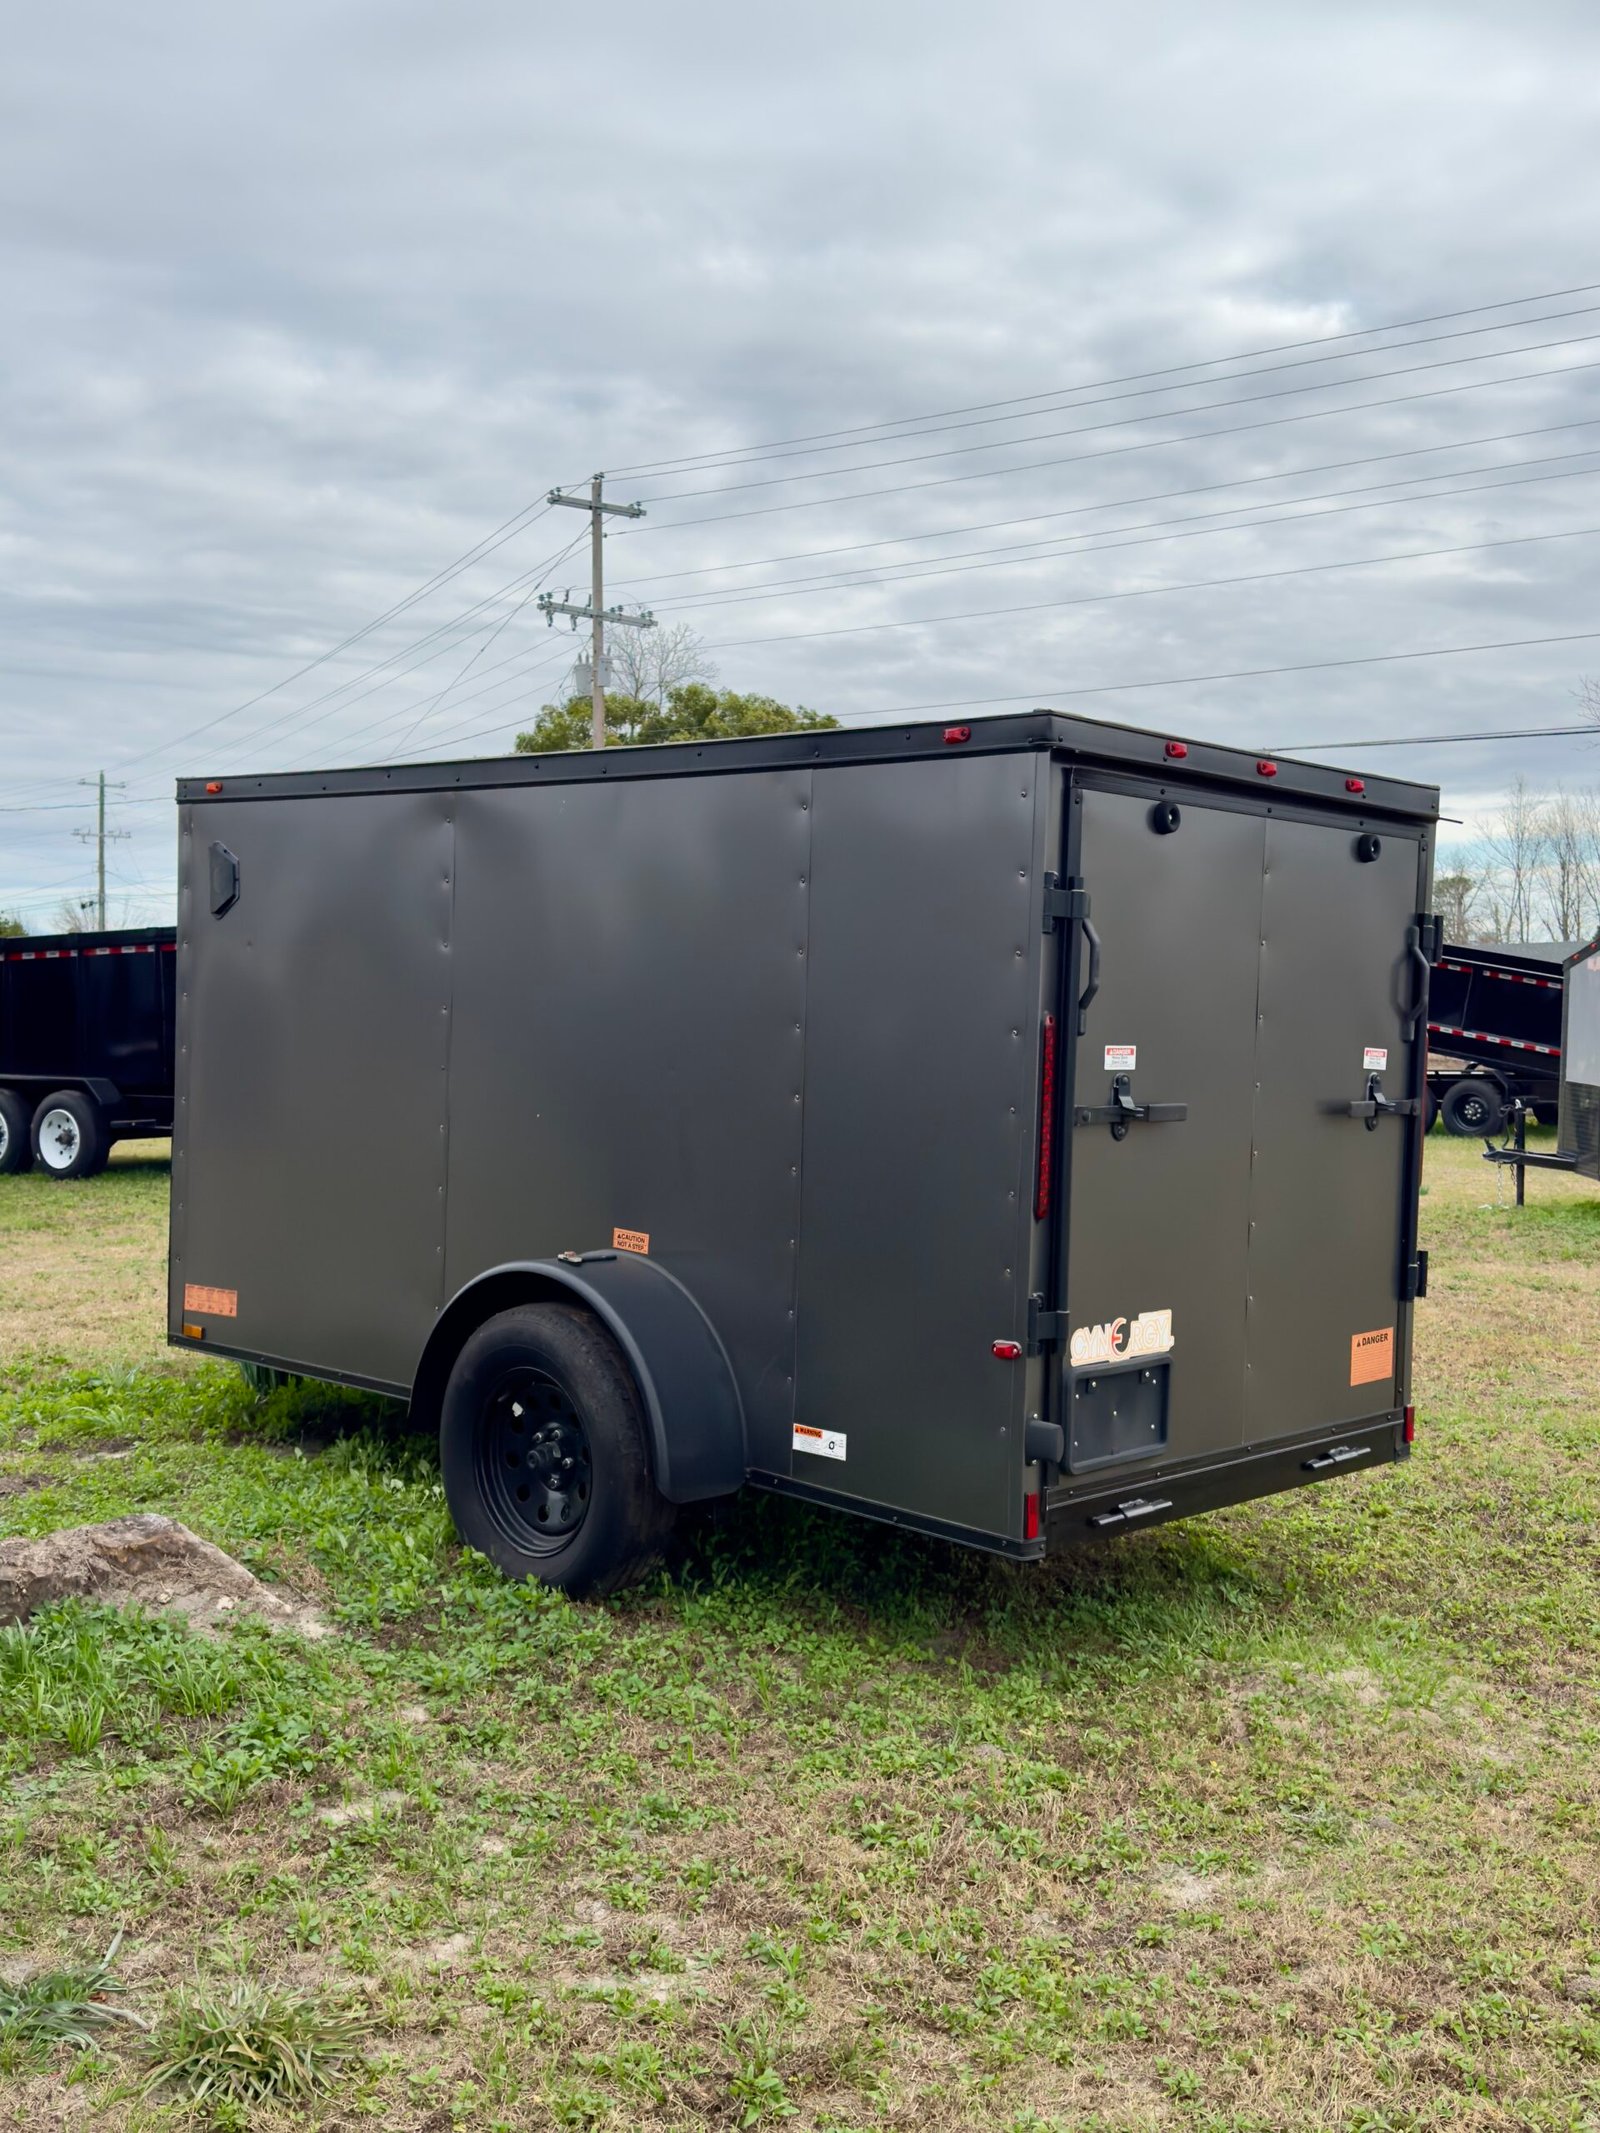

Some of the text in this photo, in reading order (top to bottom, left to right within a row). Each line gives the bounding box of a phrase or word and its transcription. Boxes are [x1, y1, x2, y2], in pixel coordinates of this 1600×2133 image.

[621, 1233, 646, 1244] CAUTION
[617, 1240, 627, 1248] NOT
[632, 1243, 645, 1251] STEP
[1071, 1316, 1171, 1360] CYNERGY
[1361, 1332, 1389, 1347] DANGER
